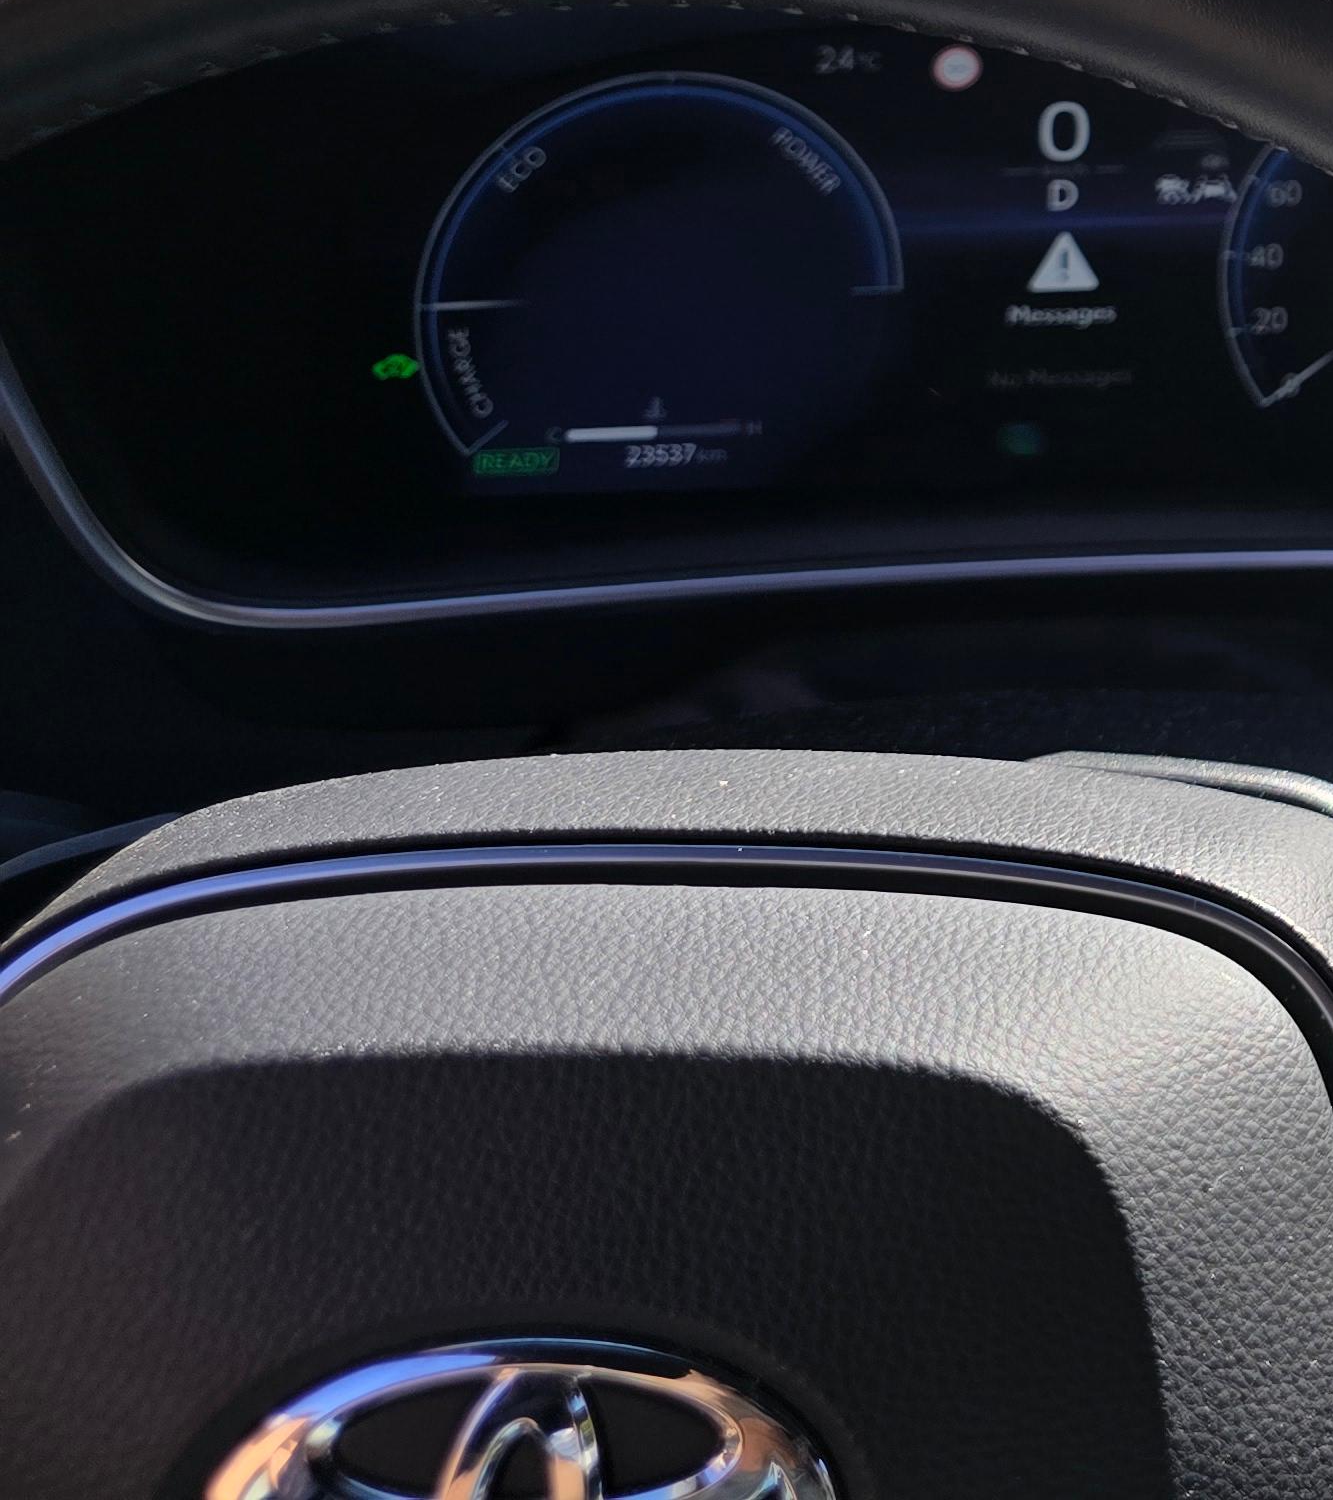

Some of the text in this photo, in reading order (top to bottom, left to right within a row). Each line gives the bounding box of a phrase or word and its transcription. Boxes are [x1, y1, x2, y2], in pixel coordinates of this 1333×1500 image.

[1038, 100, 1092, 162] 0
[496, 145, 548, 194] ECO
[769, 126, 842, 196] POWER
[1046, 178, 1080, 211] D
[1005, 303, 1117, 330] Messages
[1251, 305, 1289, 336] 20
[447, 327, 495, 419] CHARGE
[481, 449, 554, 471] READY
